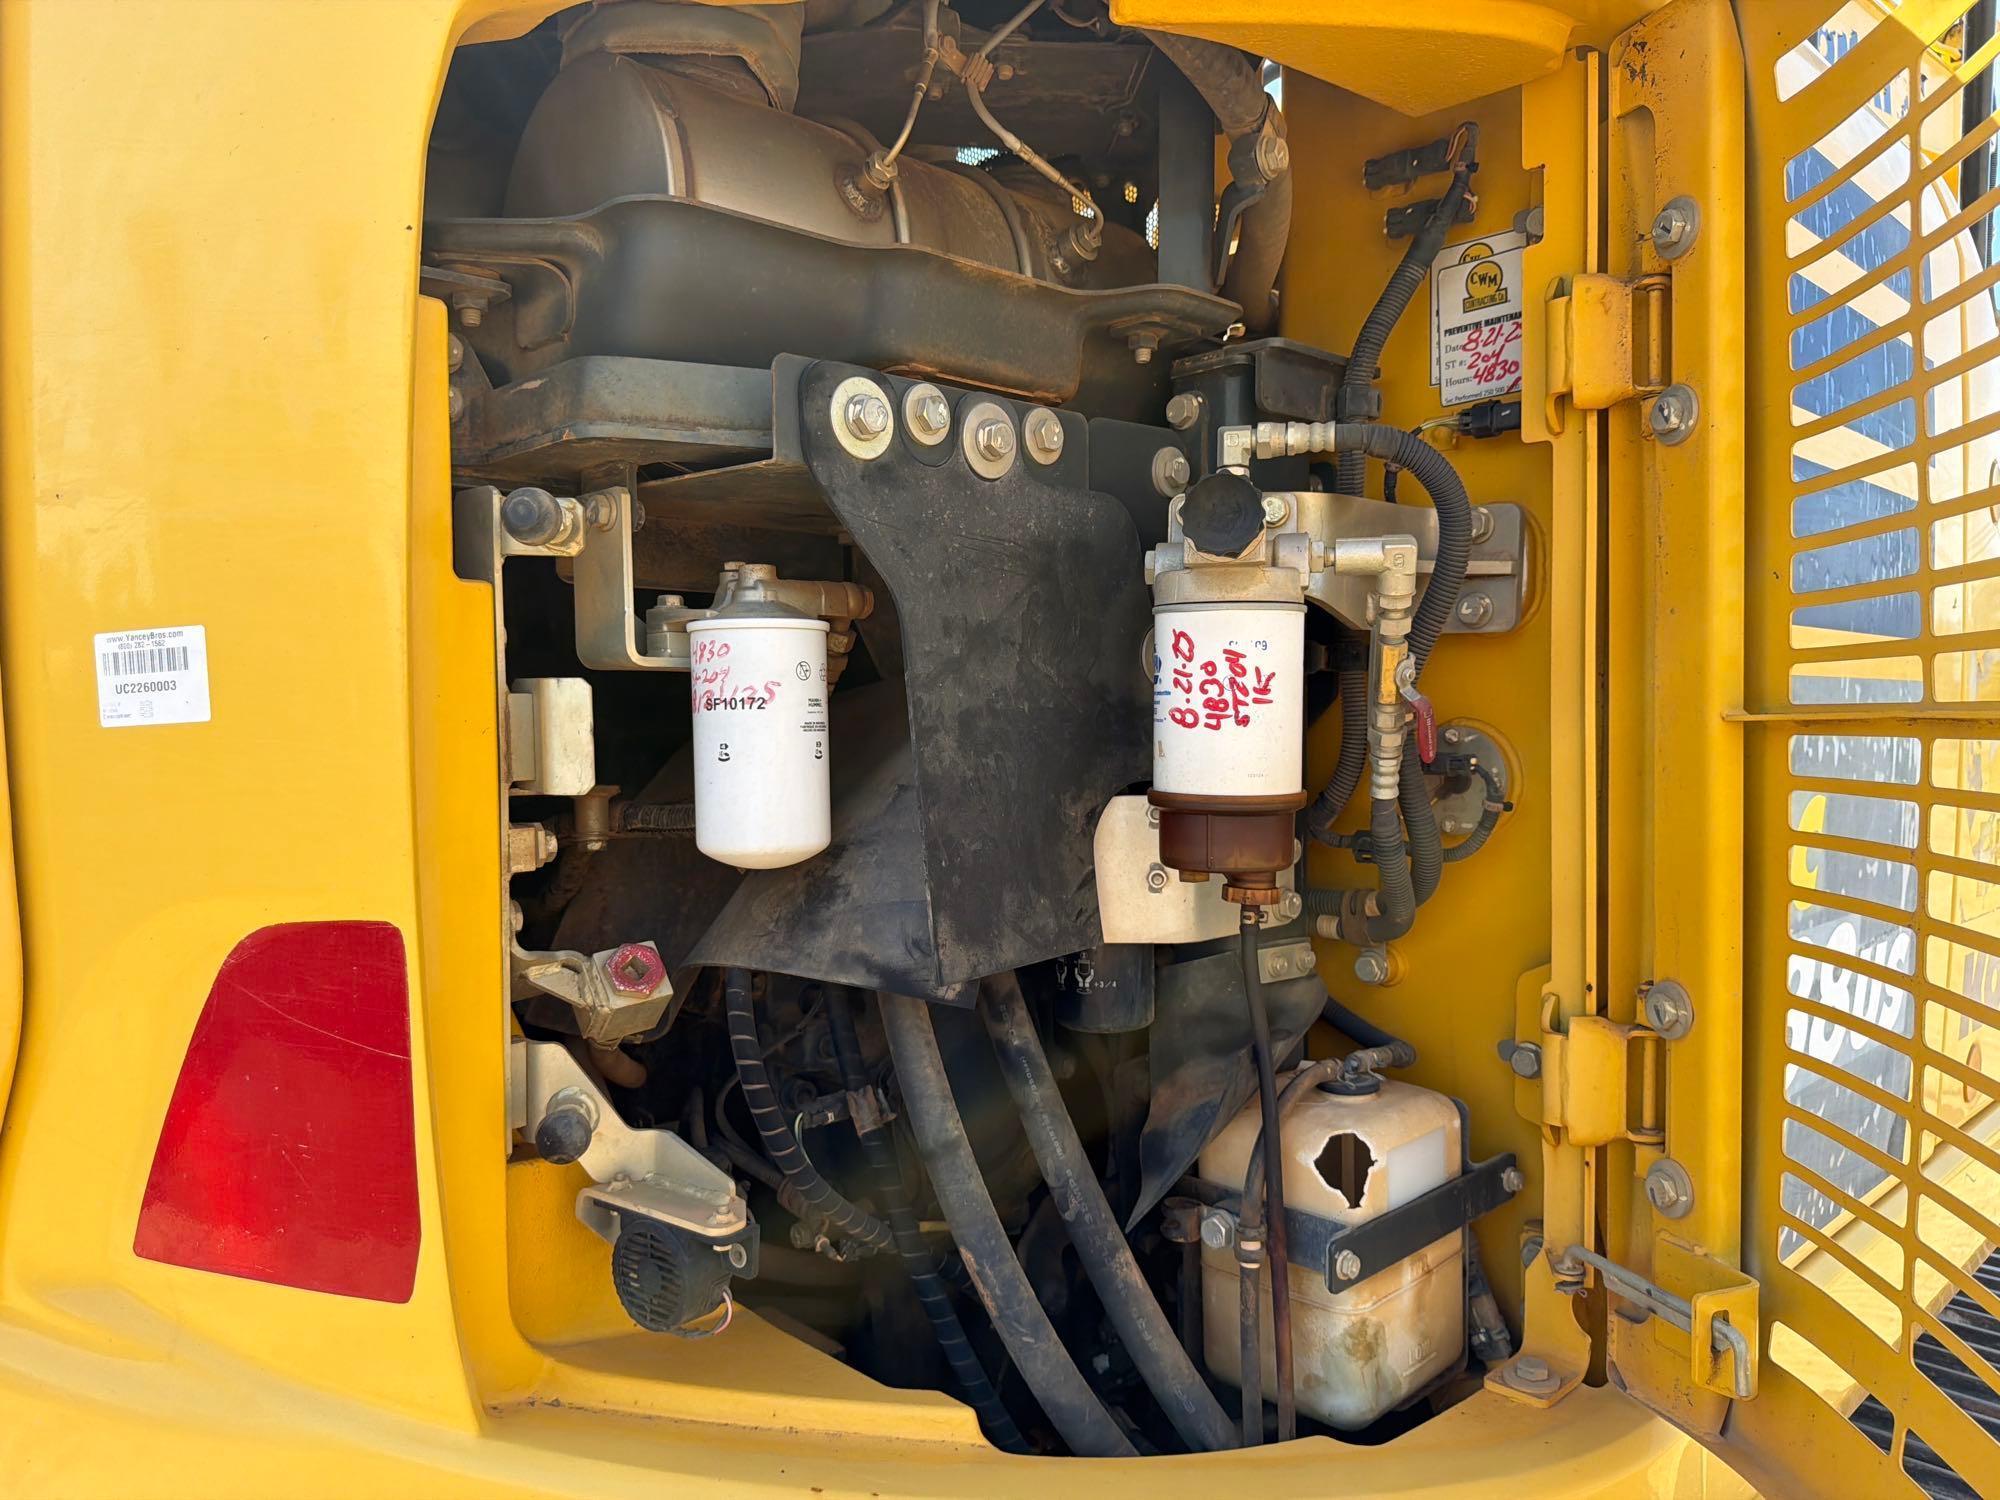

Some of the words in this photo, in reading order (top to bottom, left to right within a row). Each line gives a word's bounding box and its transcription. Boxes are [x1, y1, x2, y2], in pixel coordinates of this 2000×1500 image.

[1470, 272, 1498, 288] CWM
[1444, 321, 1482, 337] PREVENTIVE
[1467, 343, 1505, 370] 204
[1445, 360, 1457, 370] ST
[1473, 359, 1520, 385] 4830
[1445, 376, 1473, 388] Hours:
[115, 680, 177, 695] UC2260003
[1199, 660, 1233, 731] 4830
[705, 696, 766, 711] SF10172
